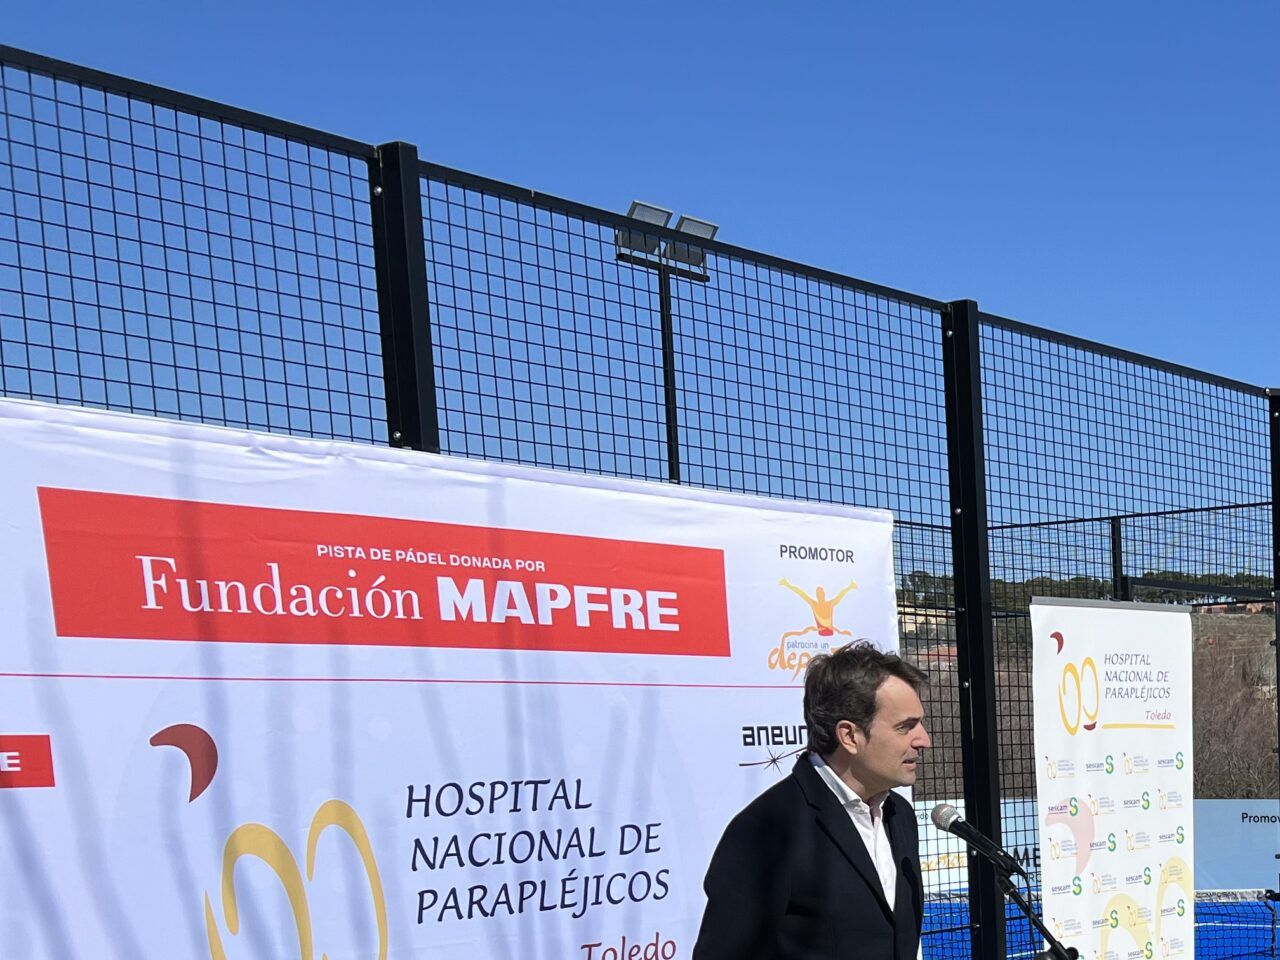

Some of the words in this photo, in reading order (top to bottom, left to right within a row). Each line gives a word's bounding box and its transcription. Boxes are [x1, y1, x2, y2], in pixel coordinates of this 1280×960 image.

[316, 544, 366, 560] PISTA
[369, 548, 393, 562] DE
[395, 548, 447, 566] PÁDEL
[449, 554, 512, 570] DONADA
[515, 559, 546, 573] POR
[779, 544, 855, 563] PROMOTOR
[135, 554, 424, 620] Fundación
[436, 576, 680, 632] MAPFRE
[787, 640, 818, 650] patrocina
[1104, 653, 1151, 666] HOSPITAL
[1104, 670, 1154, 683] NACIONAL
[1156, 670, 1169, 682] DE
[1104, 685, 1171, 703] PARAPLÉJICOS
[1145, 710, 1171, 721] Toledo
[405, 778, 593, 818] HOSPITAL
[411, 826, 606, 871] NACIONAL
[618, 822, 662, 855] DE
[416, 868, 670, 924] PARAPLÉJICOS
